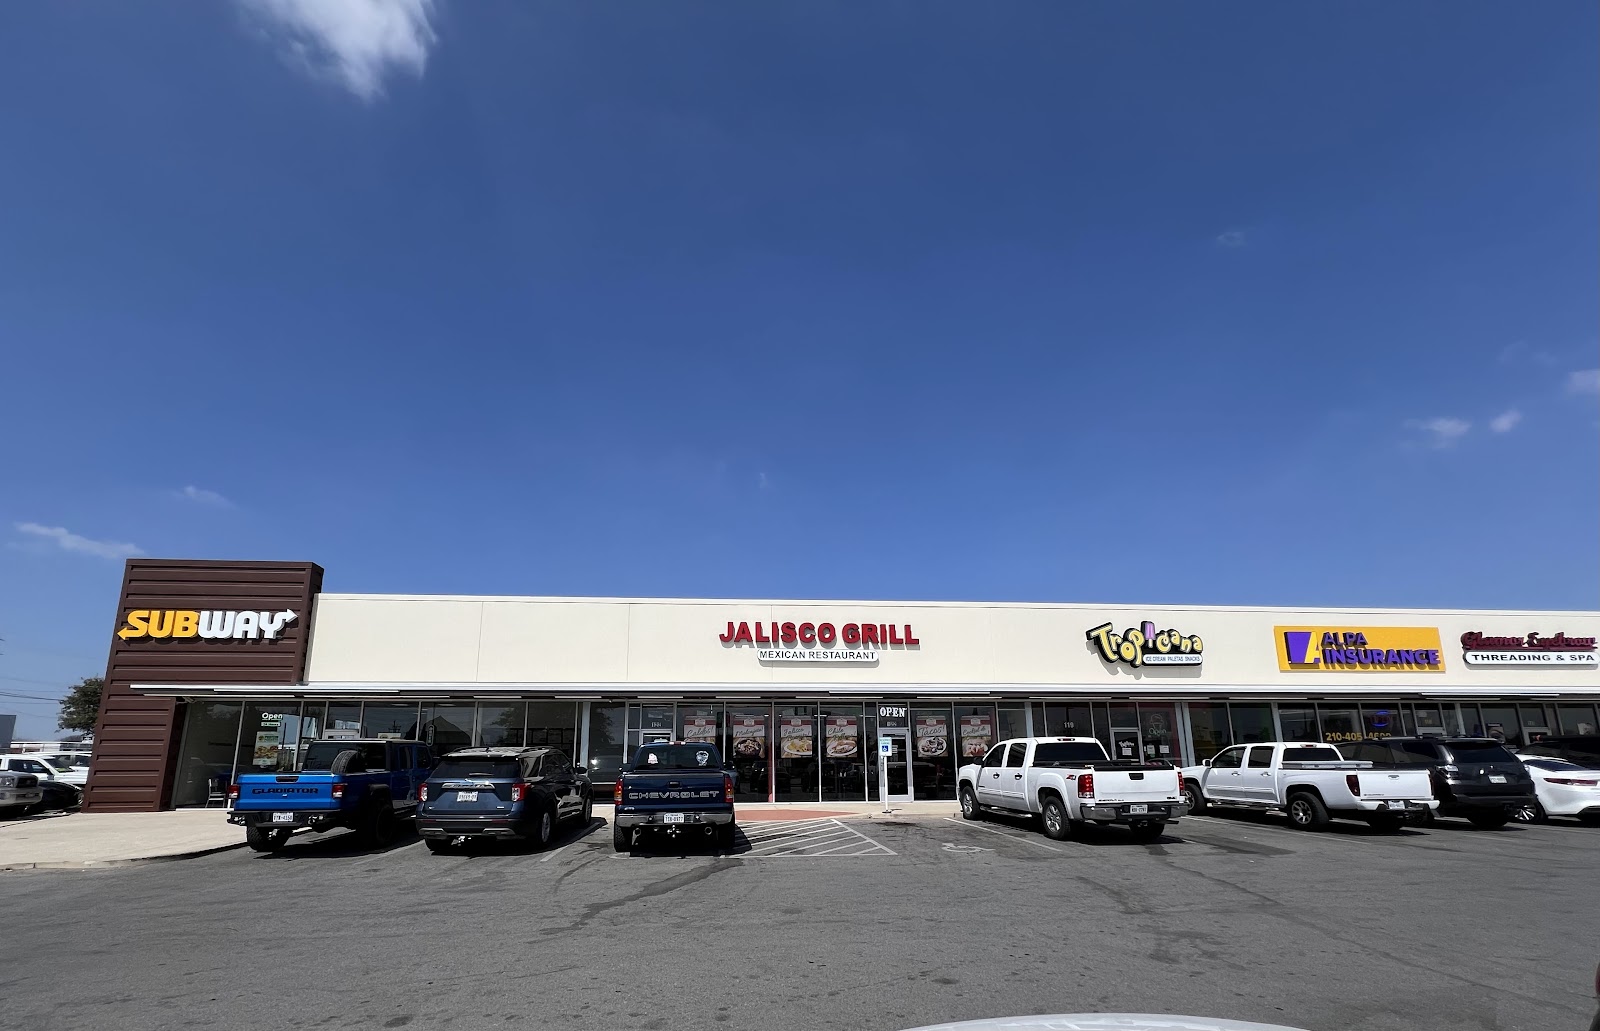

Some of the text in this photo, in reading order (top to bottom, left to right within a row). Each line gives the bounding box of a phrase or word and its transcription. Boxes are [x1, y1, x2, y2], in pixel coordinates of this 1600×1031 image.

[117, 608, 298, 640] SUBWAY
[719, 621, 920, 645] JALISCO GRILL
[1321, 632, 1368, 646] ALPA
[1086, 620, 1203, 668] Tropicana
[759, 650, 876, 660] MEXICAN RESTAURANT
[1323, 648, 1441, 665] INSURANCE
[1569, 654, 1595, 662] SPA
[261, 712, 283, 721] Open
[880, 706, 907, 718] OPEN
[918, 723, 946, 736] Tacos!
[252, 787, 318, 795] GLADIATOR
[628, 790, 720, 800] CHEVROLET
